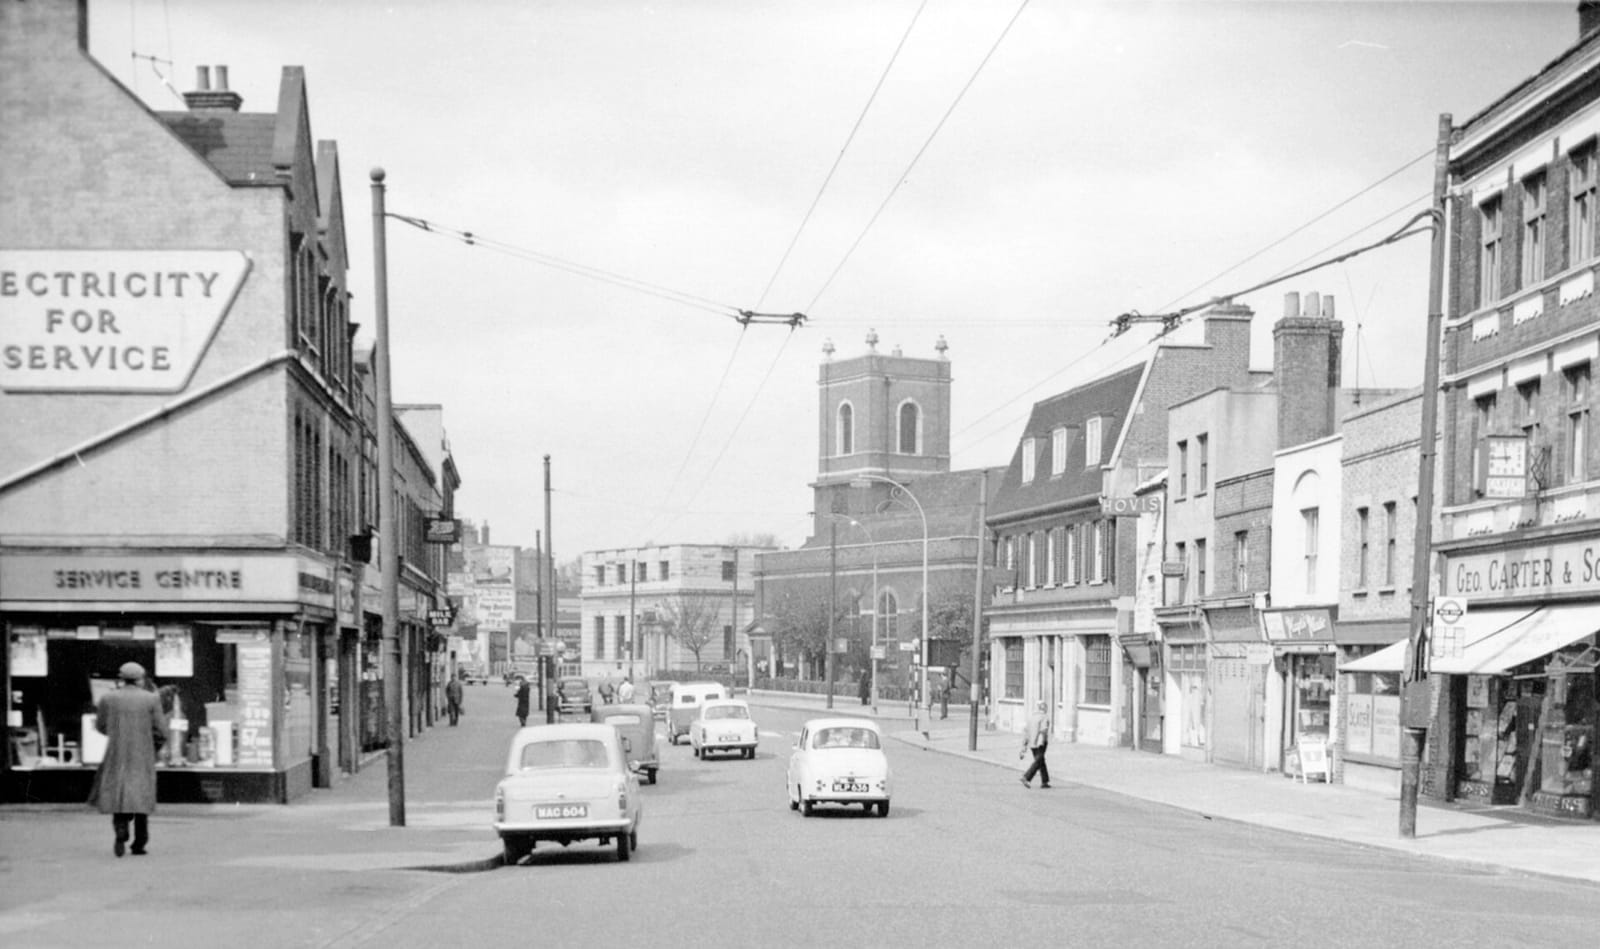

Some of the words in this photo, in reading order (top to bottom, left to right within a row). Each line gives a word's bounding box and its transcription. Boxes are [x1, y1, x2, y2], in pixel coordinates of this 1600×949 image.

[1, 271, 219, 298] ECTRICITY
[46, 308, 120, 334] FOR
[4, 345, 171, 370] SERVICE
[1103, 497, 1159, 513] HOVIS
[53, 570, 141, 589] SERVICE
[155, 570, 242, 589] CENTRE
[1488, 558, 1553, 591] CARTER
[1562, 560, 1572, 584] &
[429, 610, 451, 618] MILK
[562, 806, 586, 817] 604
